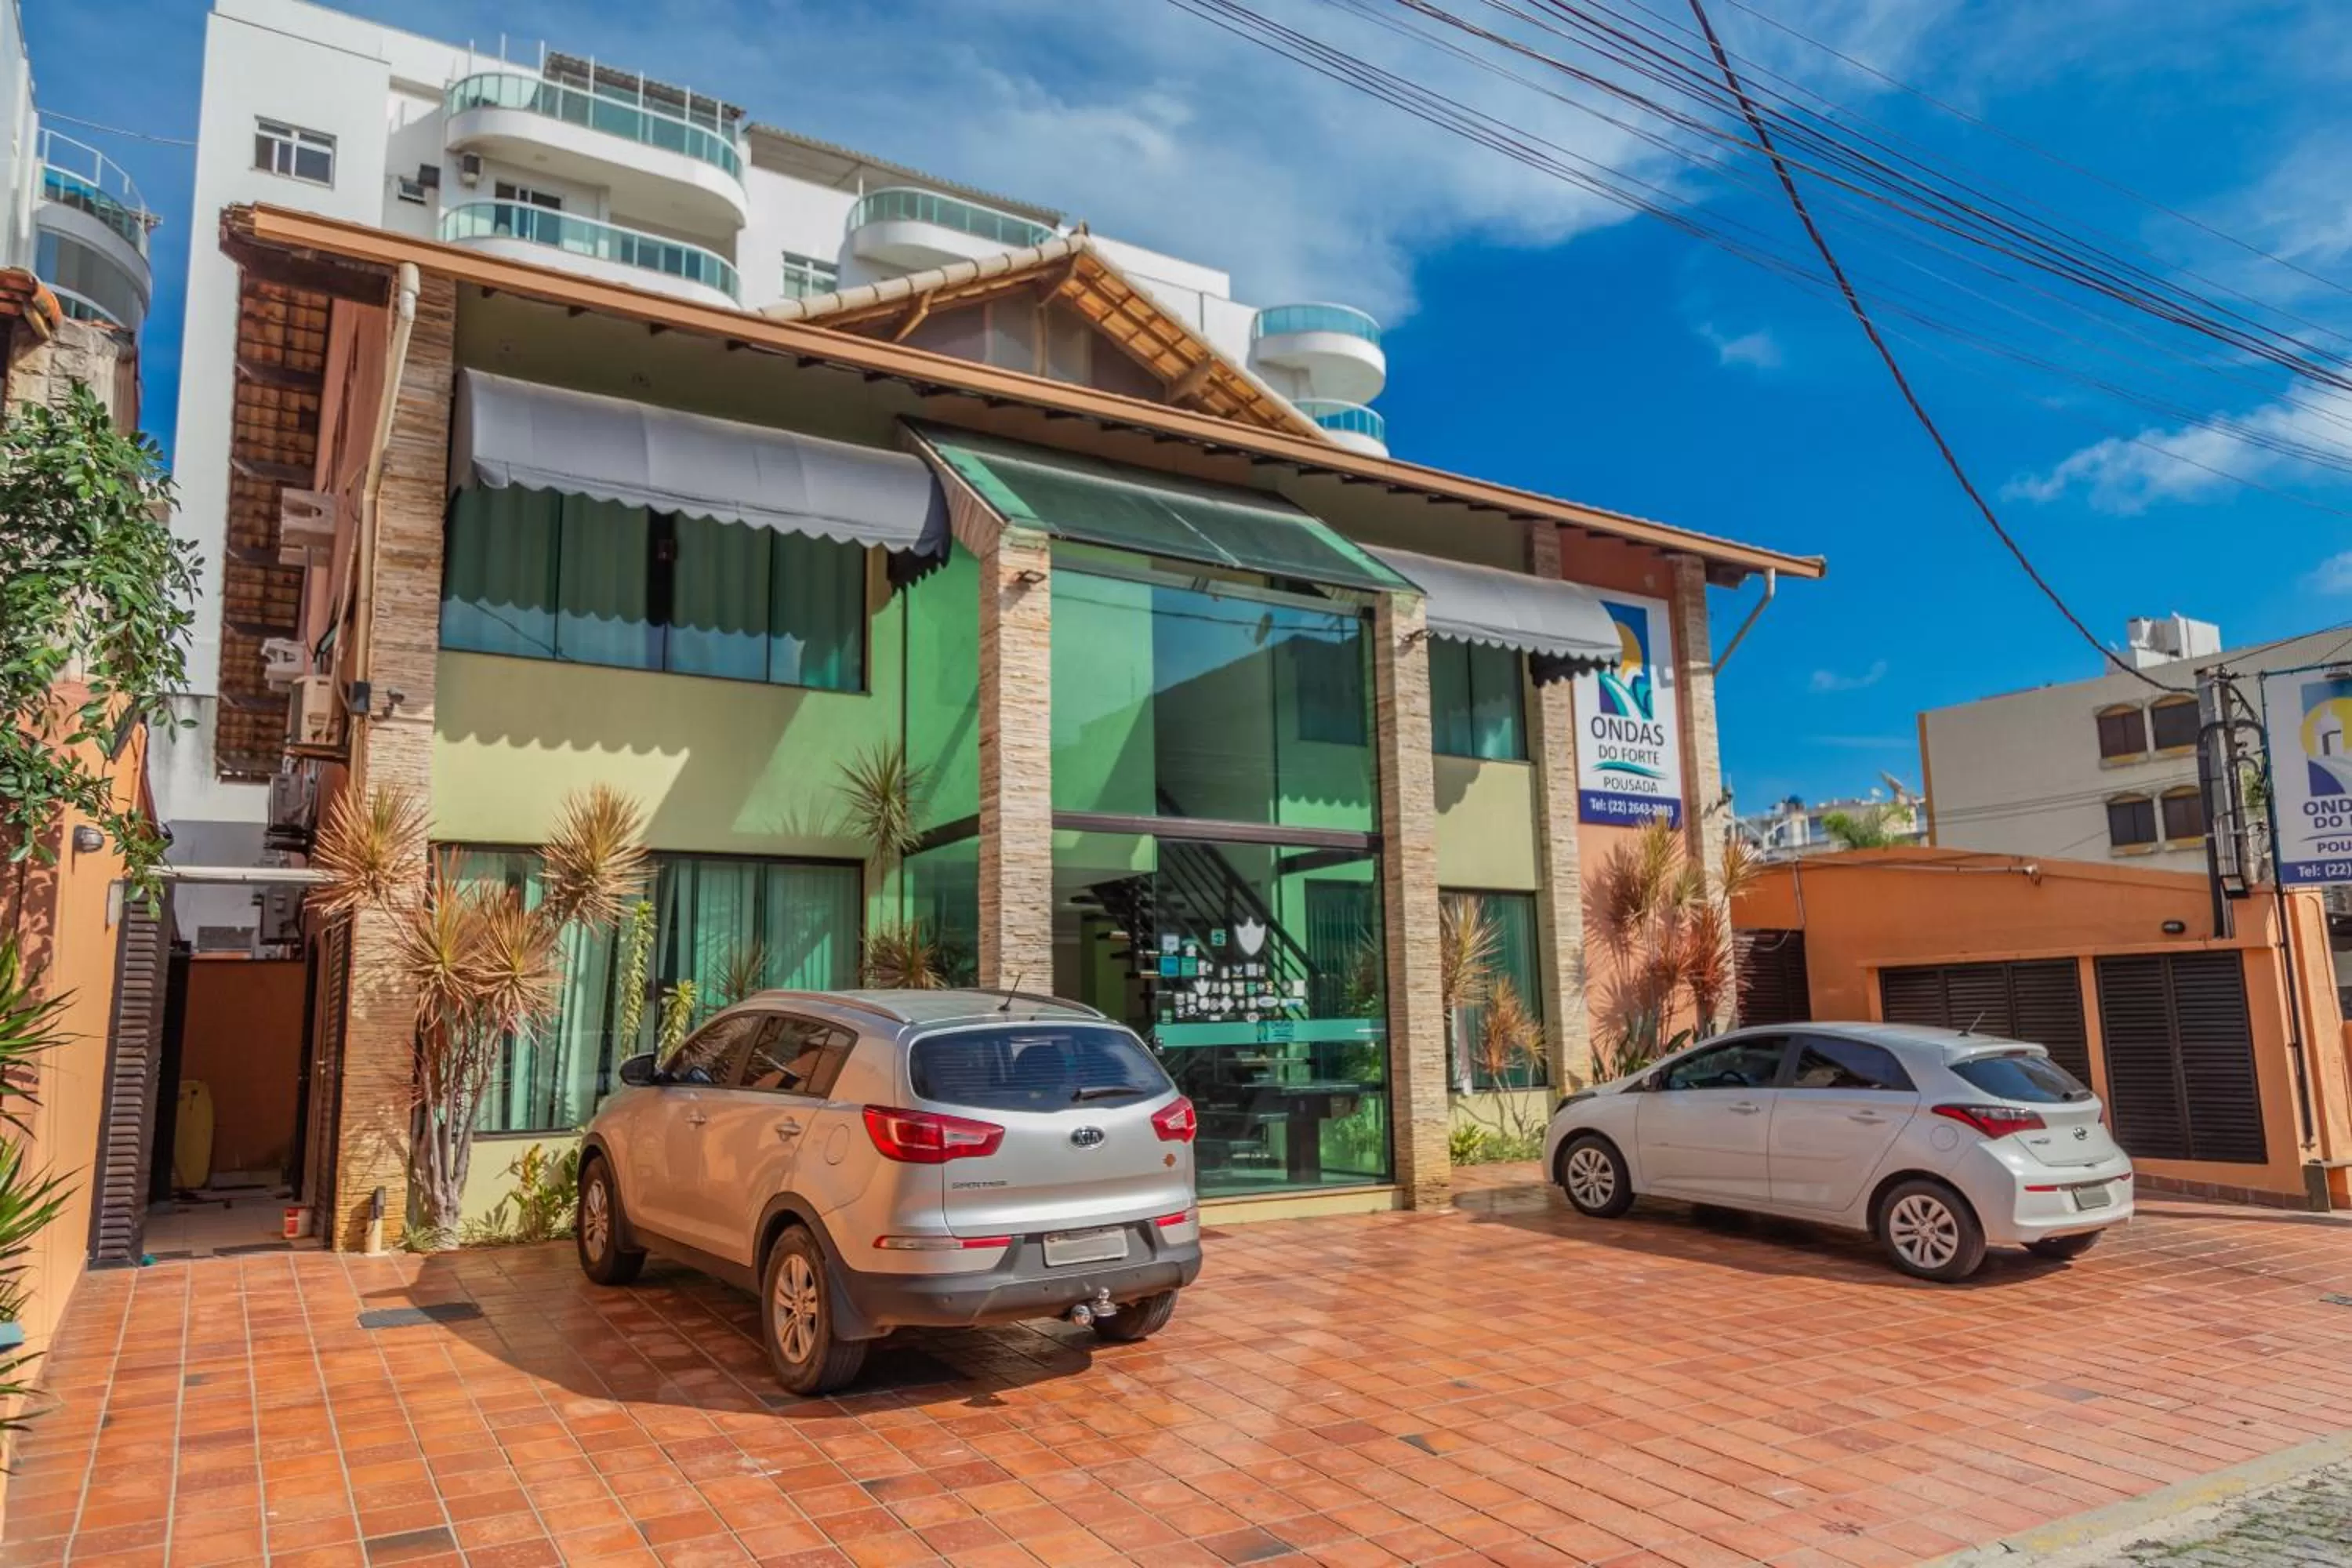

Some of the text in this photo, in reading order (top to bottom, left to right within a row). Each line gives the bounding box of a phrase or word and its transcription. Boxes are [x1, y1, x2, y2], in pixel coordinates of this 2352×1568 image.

[1591, 716, 1664, 746] ONDAS
[1599, 744, 1660, 765] DO FORTE
[1603, 776, 1658, 793] POUSADA
[1590, 797, 1606, 811] Tel:
[1608, 798, 1627, 815] (22)
[2313, 815, 2343, 829] DO
[2298, 862, 2351, 878] Tel: (22)
[1076, 1129, 1101, 1145] KIA
